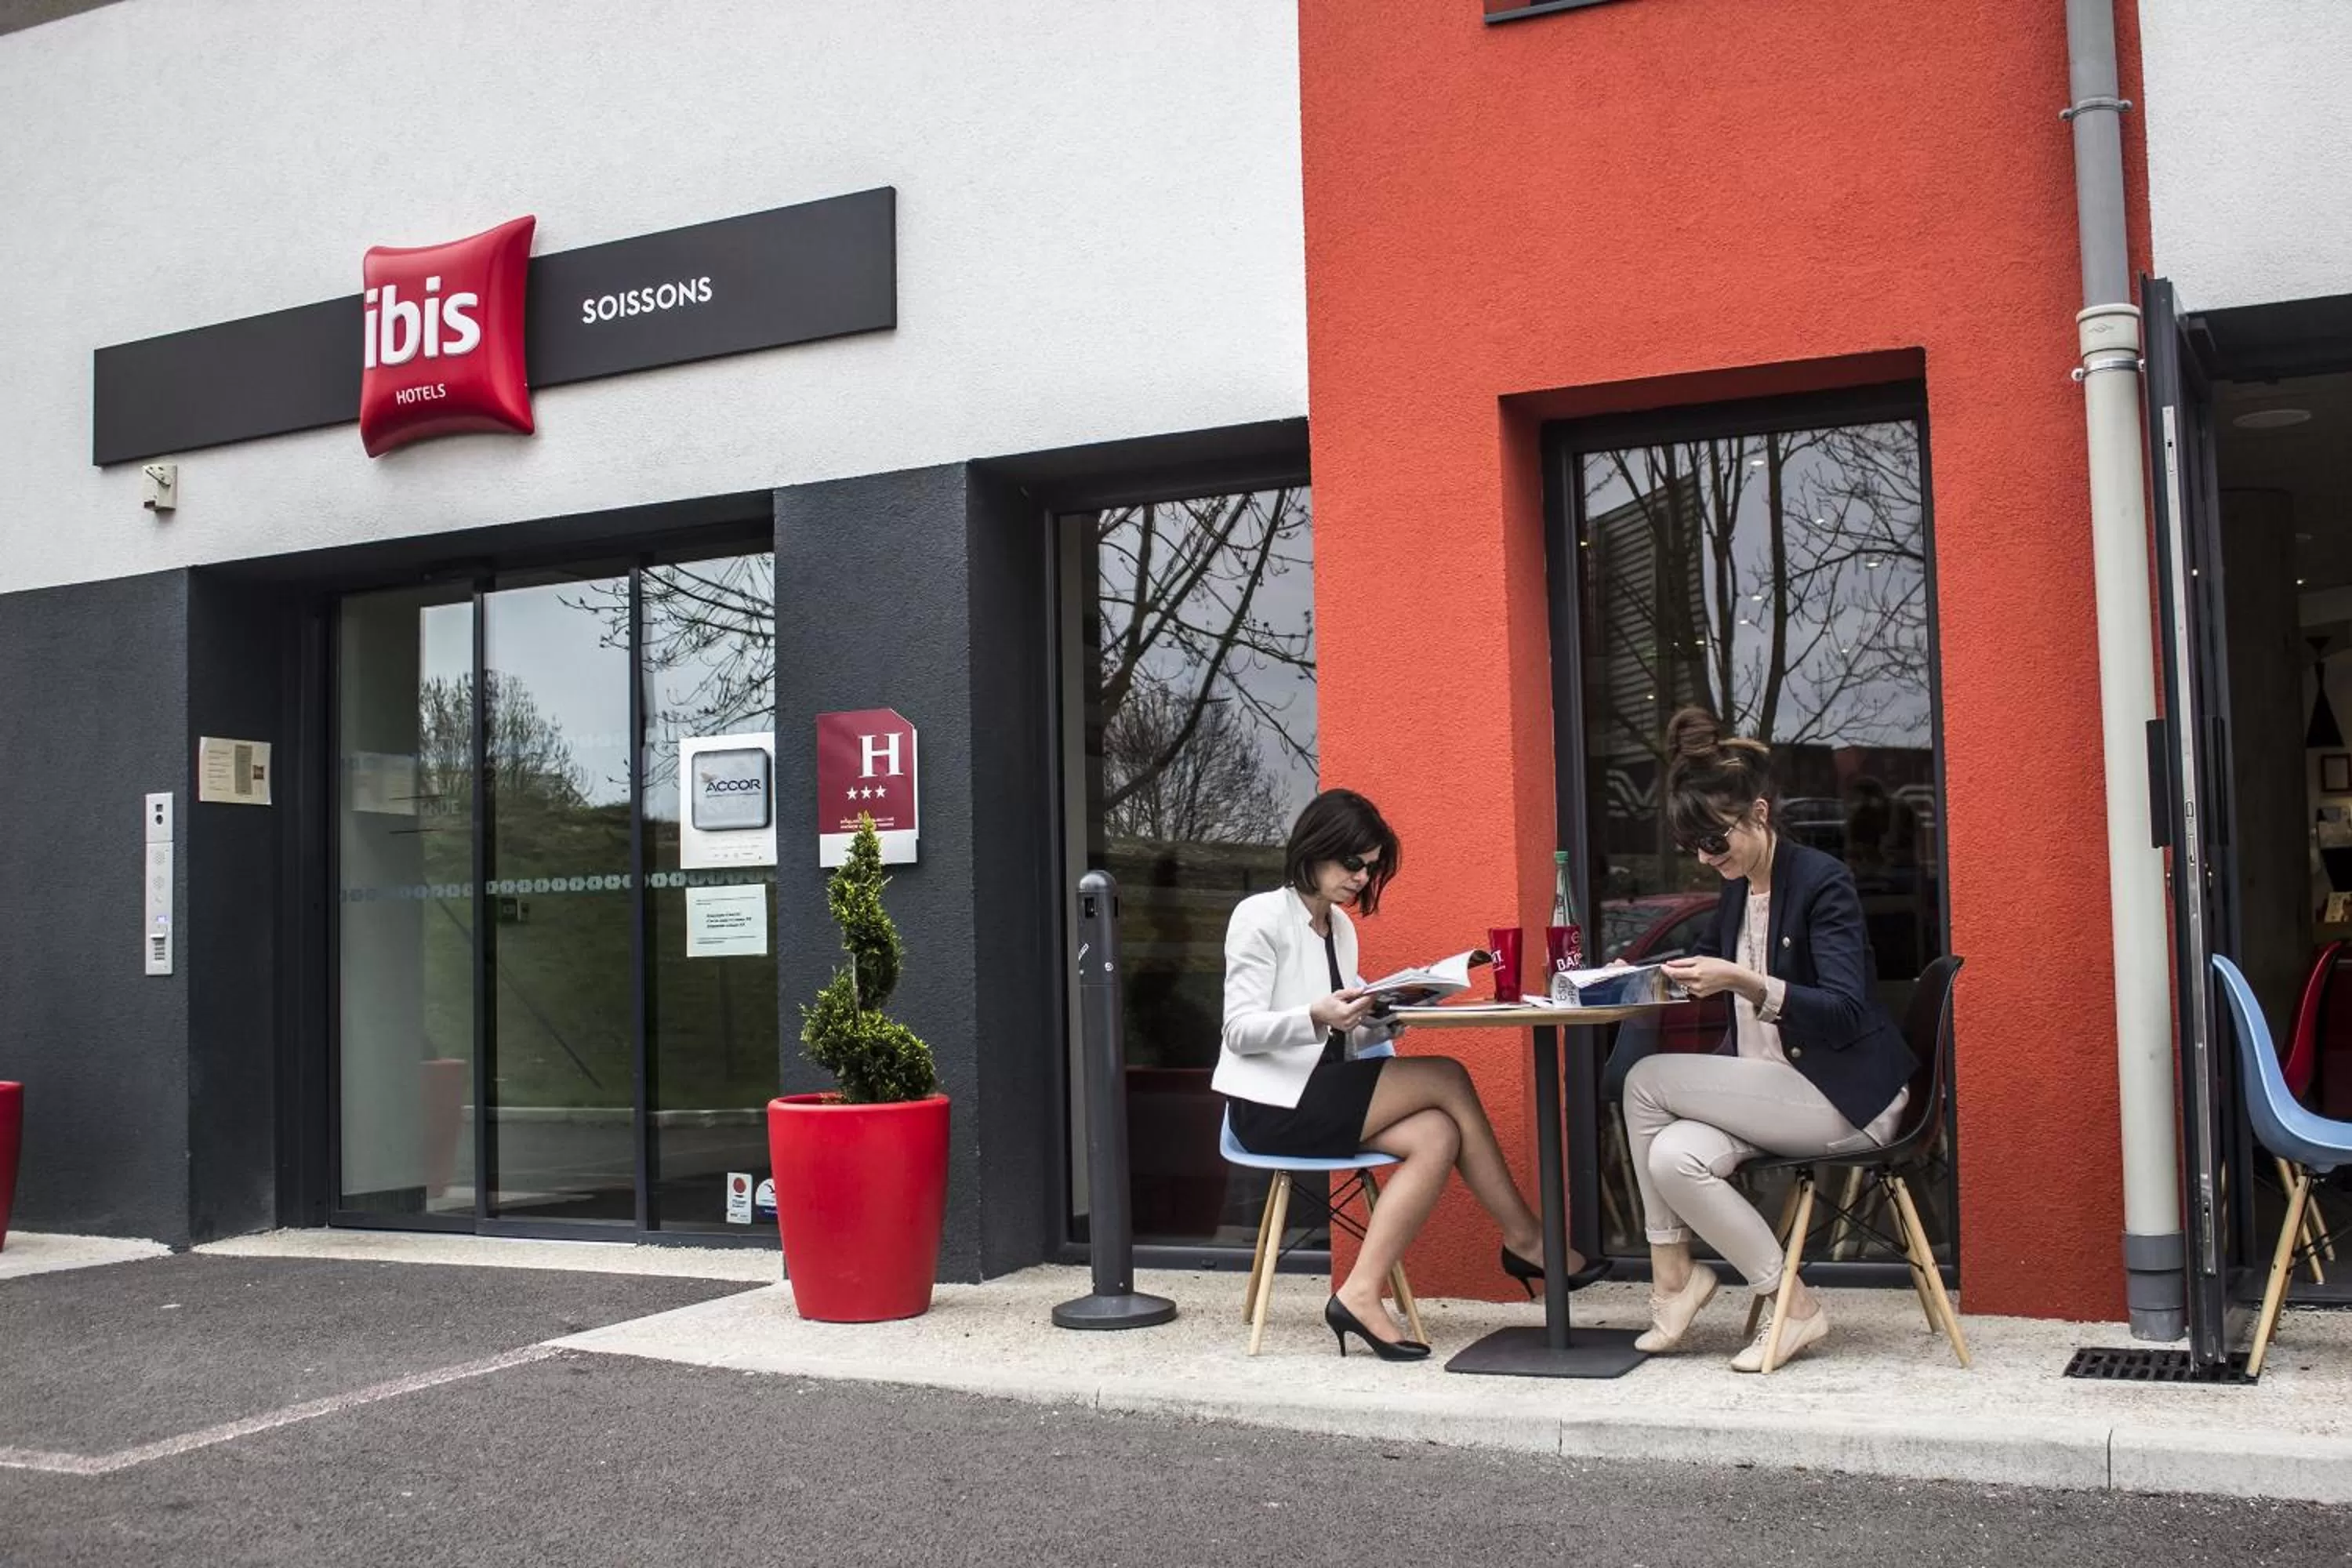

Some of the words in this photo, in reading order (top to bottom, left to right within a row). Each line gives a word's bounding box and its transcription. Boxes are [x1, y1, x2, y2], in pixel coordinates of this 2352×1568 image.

[365, 276, 481, 369] ibis
[583, 276, 713, 324] SOISSONS
[396, 383, 446, 405] HOTELS
[858, 731, 904, 779] H
[706, 779, 761, 793] ACCOR
